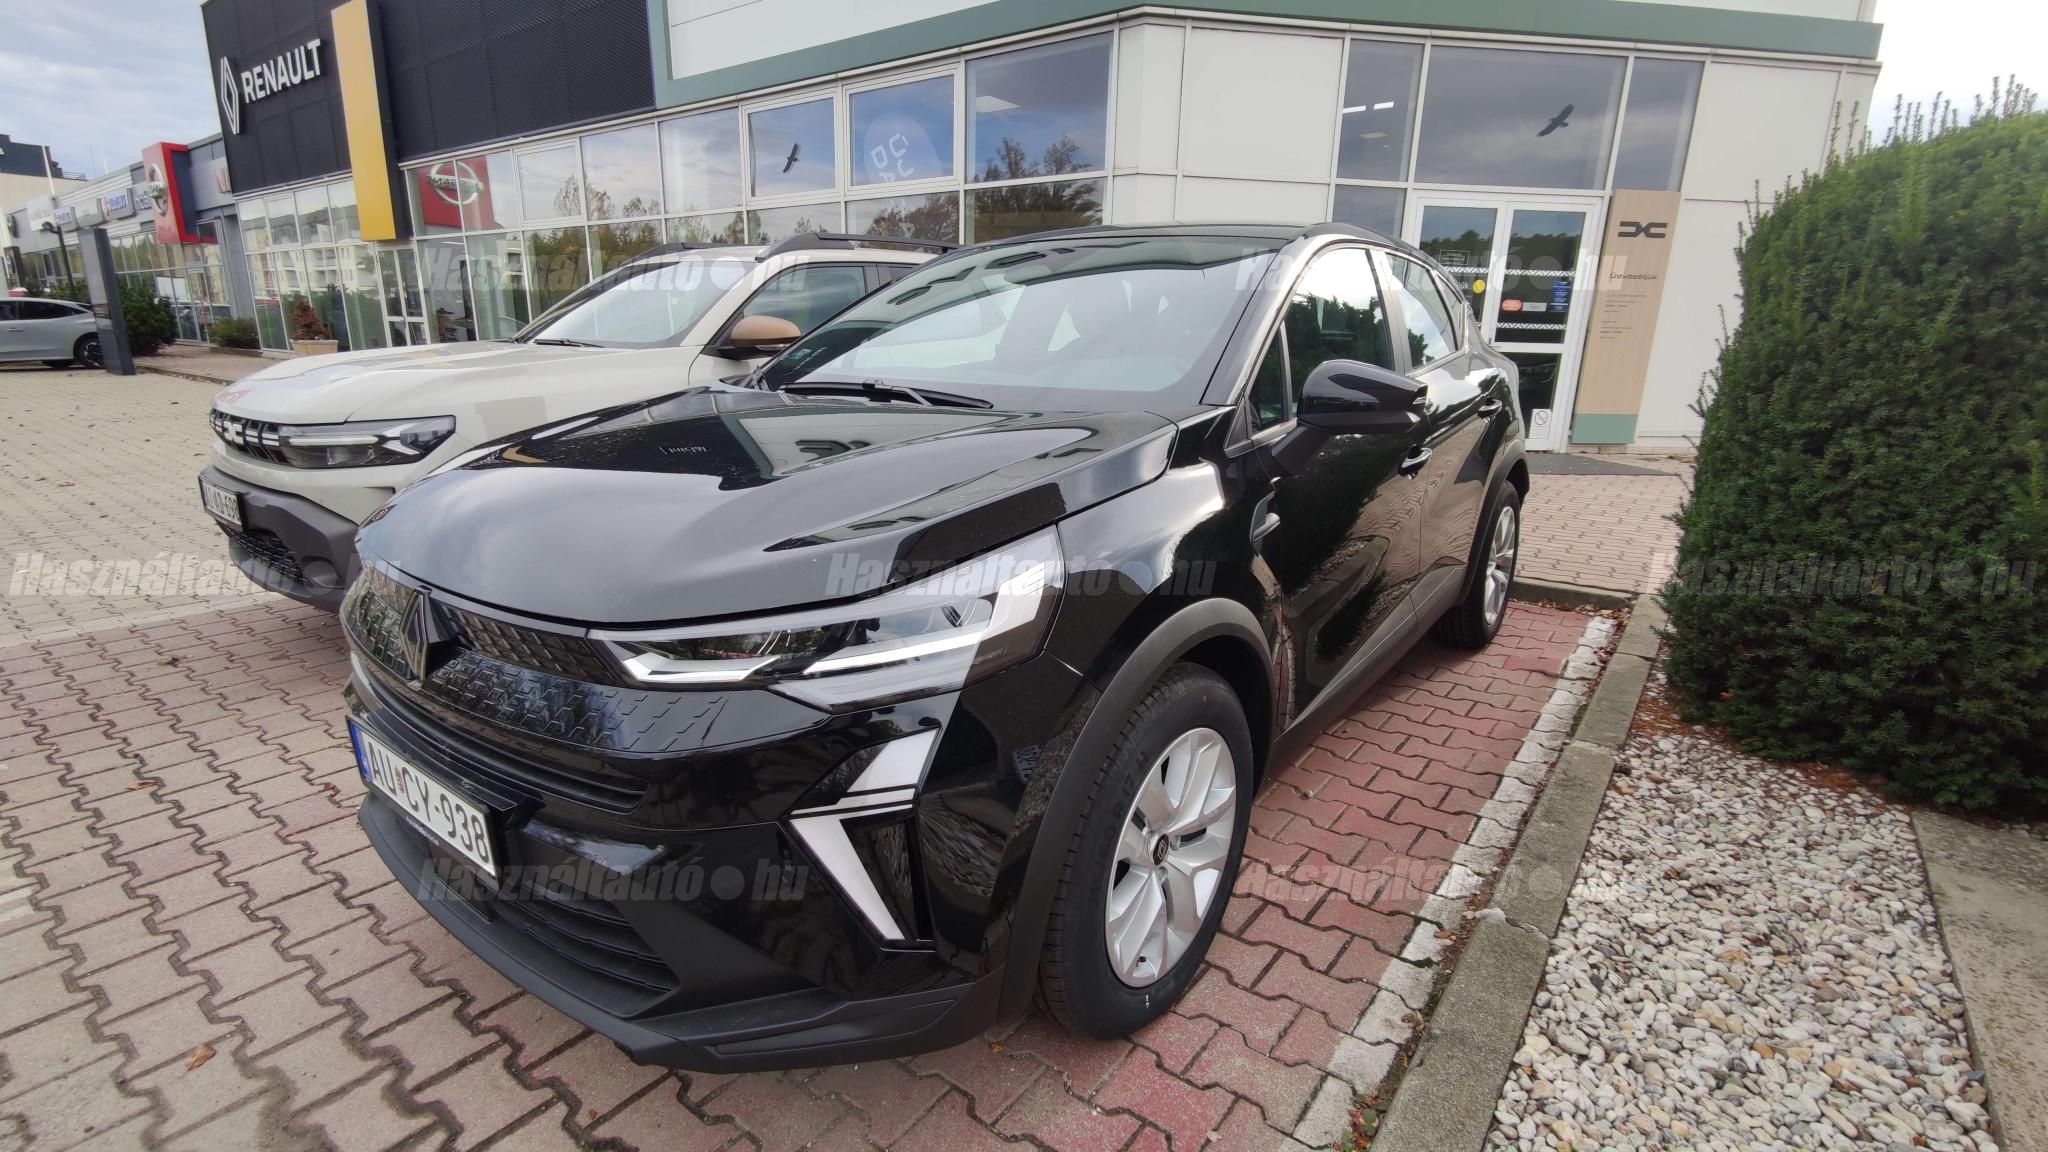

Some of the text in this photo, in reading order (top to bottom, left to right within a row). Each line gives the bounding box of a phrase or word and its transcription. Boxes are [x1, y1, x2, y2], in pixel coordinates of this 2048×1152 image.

[241, 38, 321, 103] RENAULT
[367, 741, 398, 797] AU
[402, 766, 490, 864] CY-938
